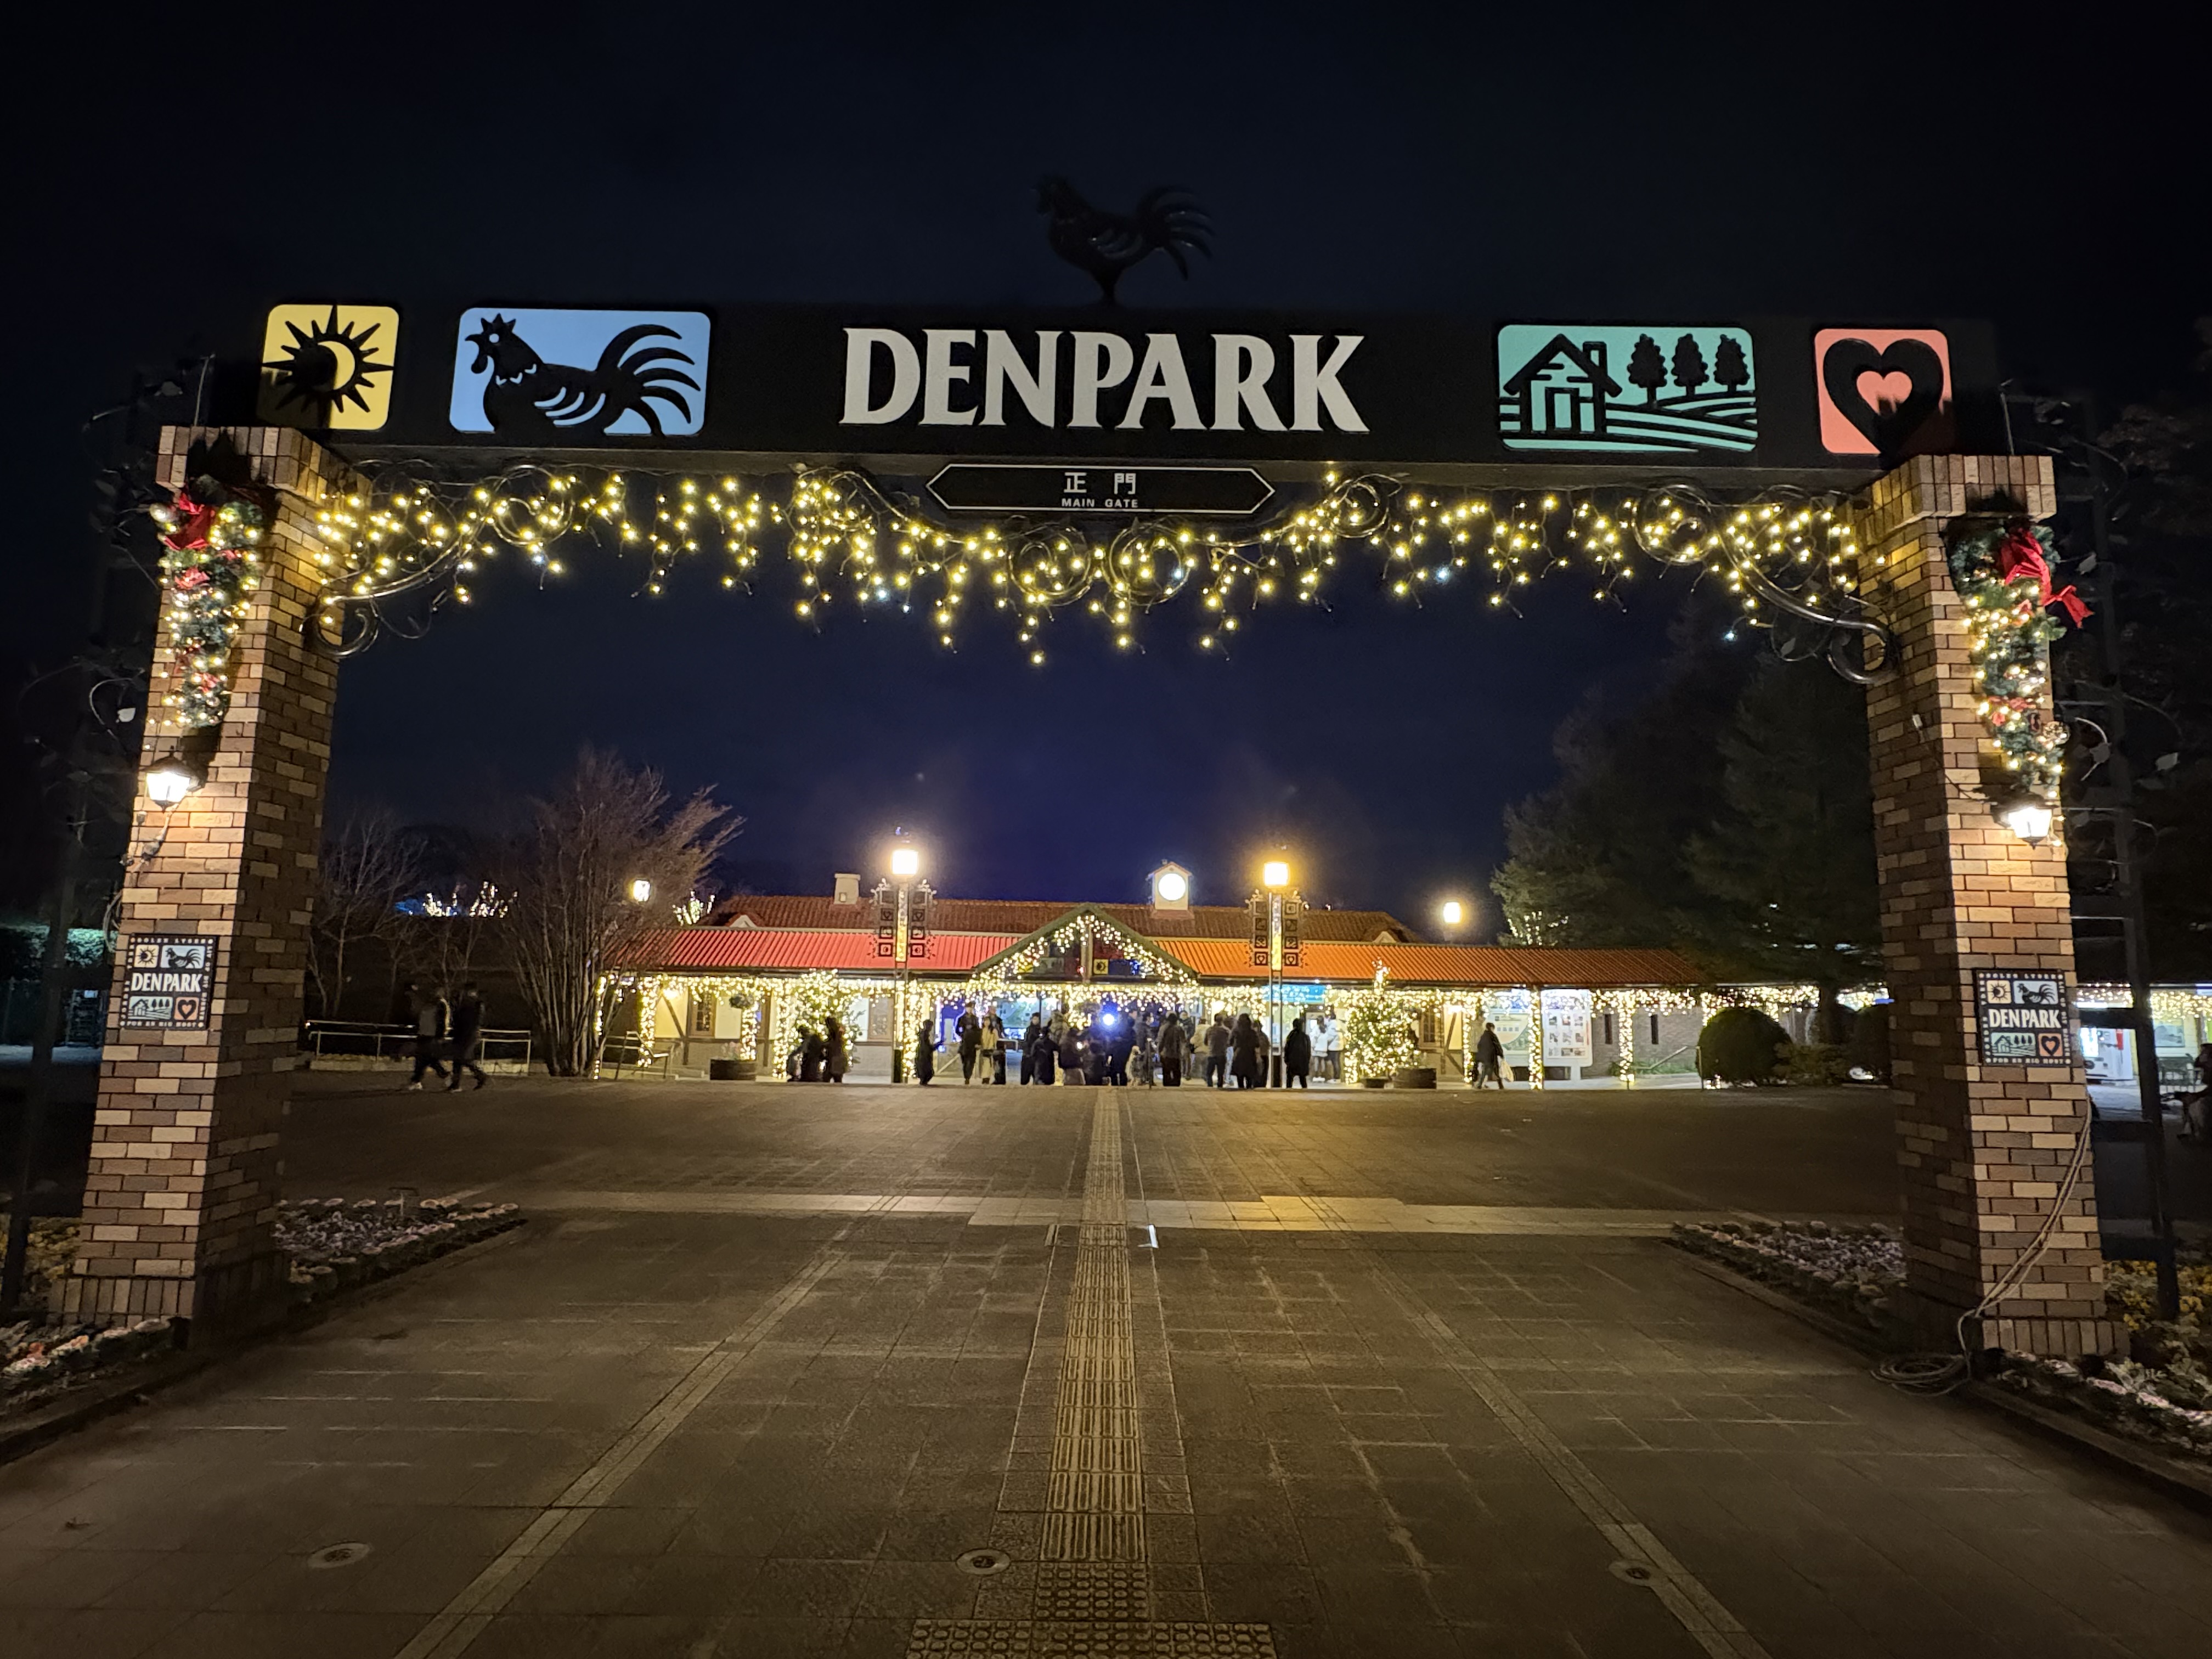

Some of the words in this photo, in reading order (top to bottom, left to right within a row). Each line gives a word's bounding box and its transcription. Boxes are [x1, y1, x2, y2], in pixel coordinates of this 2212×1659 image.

[839, 328, 1370, 432] DENPARK
[1064, 472, 1136, 495] 正門
[1062, 498, 1095, 507] MAIN
[1104, 499, 1138, 508] GATE
[131, 973, 203, 992] DENPARK
[1988, 1008, 2062, 1028] DENPARK
